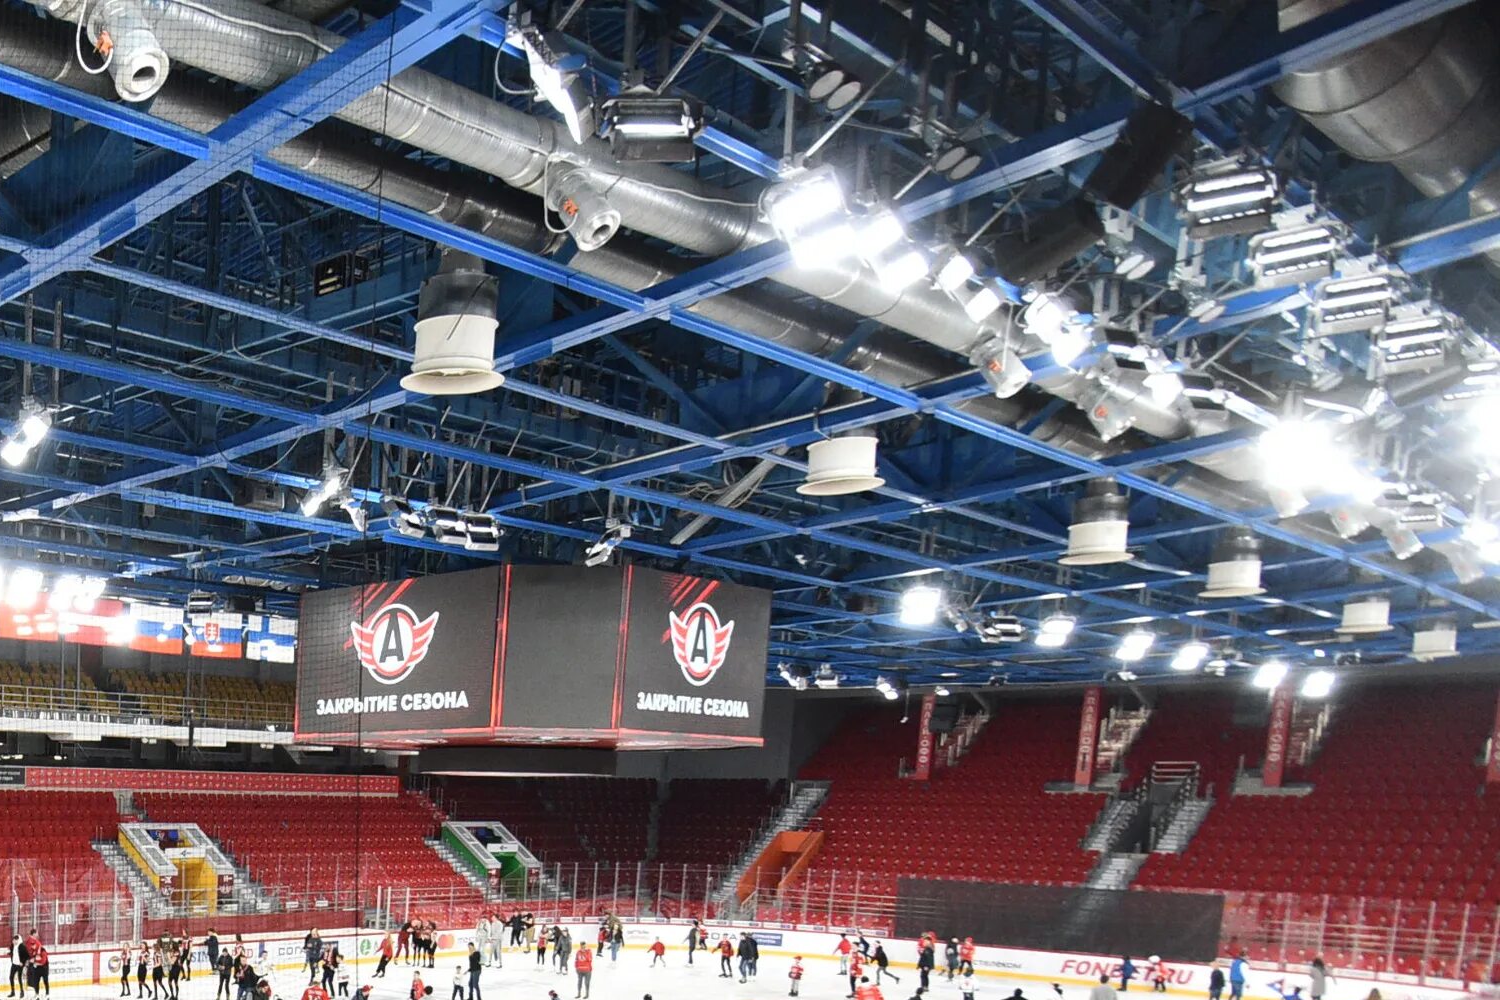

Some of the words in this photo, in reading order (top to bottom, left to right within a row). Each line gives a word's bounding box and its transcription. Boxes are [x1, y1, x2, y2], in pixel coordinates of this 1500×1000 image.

[316, 694, 397, 716] ЗАКРЫТИЕ
[400, 690, 470, 712] СЕЗОНА
[636, 691, 702, 715] ЗАКРЫТИЕ
[703, 698, 750, 718] СЕЗОНА
